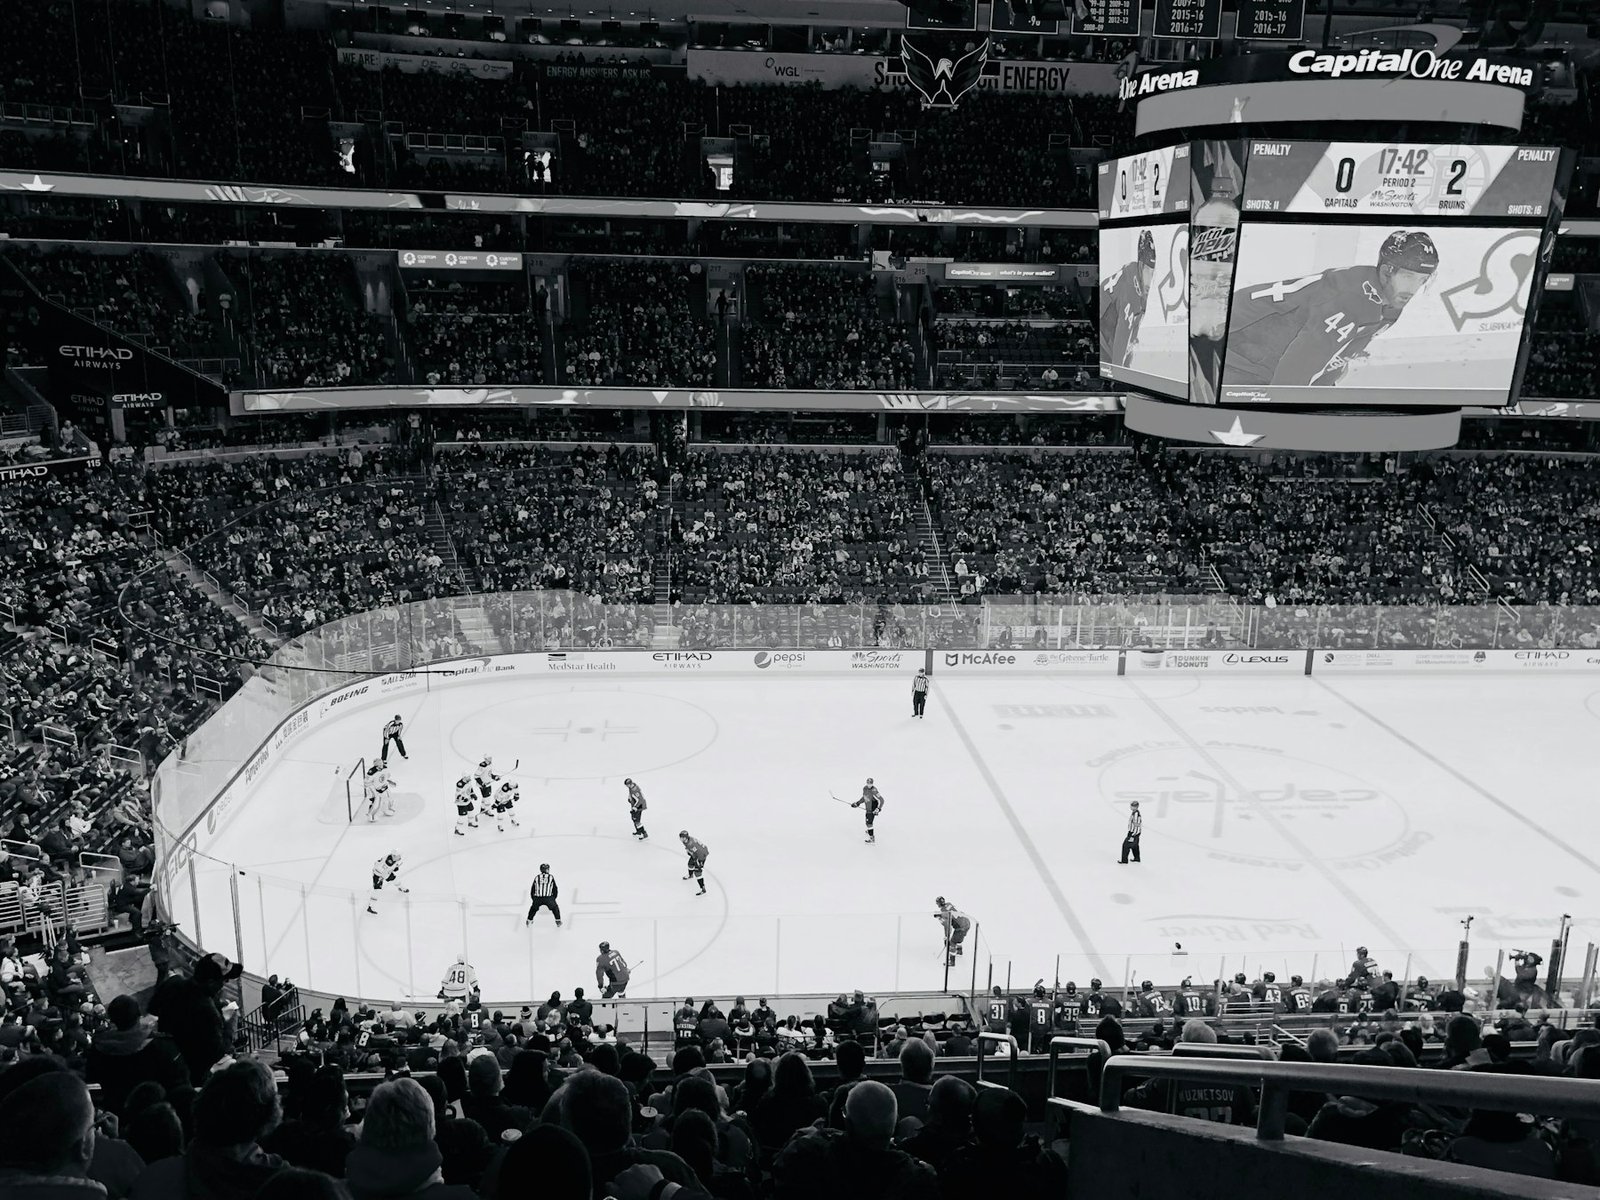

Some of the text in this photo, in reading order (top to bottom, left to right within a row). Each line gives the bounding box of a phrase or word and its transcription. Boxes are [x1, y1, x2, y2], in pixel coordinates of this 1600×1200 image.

[1171, 10, 1204, 20] 2015-16
[1255, 10, 1287, 22] 2015-16
[1170, 22, 1203, 33] 2016-17
[1253, 23, 1286, 34] 2016-17
[342, 52, 357, 64] WE
[546, 66, 578, 77] ENERGY
[622, 69, 638, 79] ASK
[774, 66, 800, 77] WGL
[1466, 57, 1533, 87] Arena
[1003, 66, 1070, 91] ENERGY
[1137, 69, 1199, 95] Arena
[1253, 144, 1291, 156] PENALTY
[1518, 149, 1556, 162] PENALTY
[1378, 148, 1428, 176] 17:42
[1154, 163, 1162, 195] 2
[1335, 157, 1356, 193] 0
[1446, 159, 1468, 196] 2
[1382, 177, 1416, 188] PERIOD 2
[1384, 190, 1418, 202] Sports
[1246, 199, 1273, 210] SHOTS:
[1324, 197, 1358, 208] CAPITALS
[1438, 199, 1466, 210] BRUINS
[1507, 204, 1534, 215] SHOTS:
[894, 276, 906, 284] 216
[1324, 312, 1355, 343] 44
[59, 344, 133, 360] ETIHAD
[73, 360, 121, 370] AIRWAYS
[70, 394, 104, 406] ETIHAD
[111, 392, 162, 402] ETIHAD
[86, 458, 101, 468] 115
[0, 466, 48, 481] TIHAD
[652, 652, 712, 661] ETIHAD
[773, 651, 806, 664] pepsi
[866, 651, 903, 663] Sports
[962, 652, 1016, 665] McAfee
[1240, 656, 1288, 664] LEXUS
[1514, 651, 1571, 660] ETIHAD
[495, 664, 515, 672] Bank
[548, 662, 616, 671] MedStar Health
[330, 685, 369, 707] BOEING
[1157, 922, 1323, 943] Red River
[449, 970, 465, 984] 48
[1265, 989, 1281, 1003] 43
[1186, 996, 1201, 1012] 10
[991, 1004, 1005, 1020] 31
[1037, 1008, 1046, 1025] 8
[470, 1013, 479, 1029] 8
[358, 1031, 370, 1047] 8
[1178, 1088, 1234, 1102] KUZNETSOV
